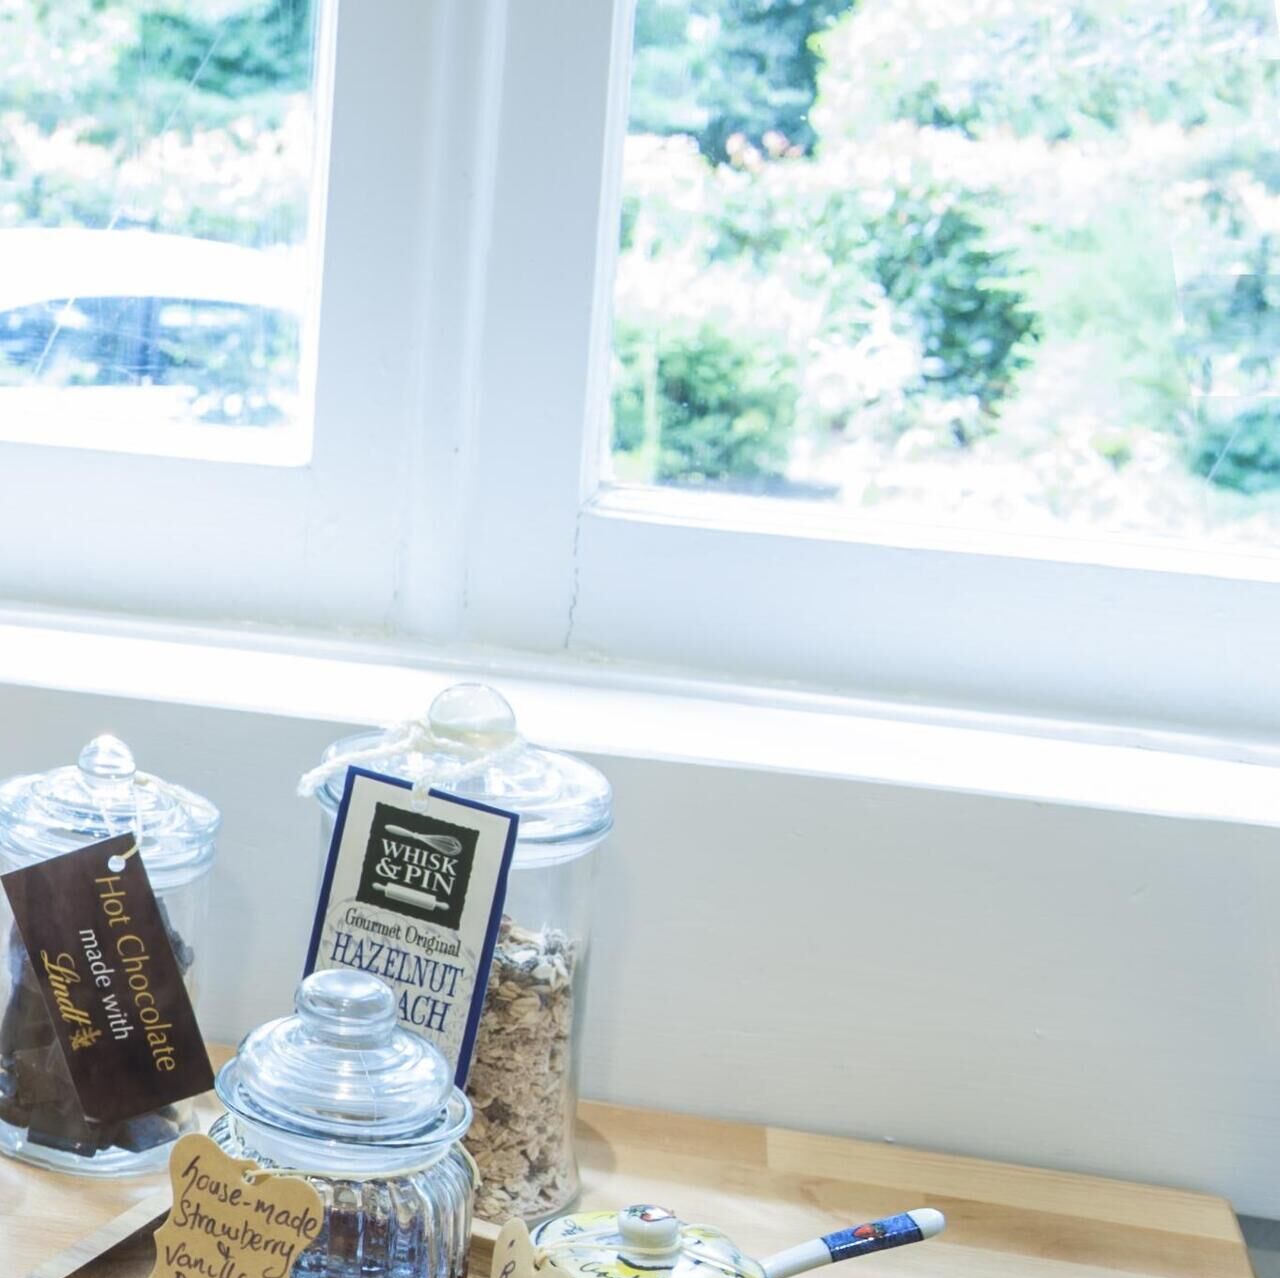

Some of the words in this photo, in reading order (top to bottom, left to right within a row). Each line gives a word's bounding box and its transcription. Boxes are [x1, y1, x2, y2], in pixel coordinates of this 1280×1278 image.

[375, 857, 402, 880] &
[404, 865, 457, 896] PIN
[382, 838, 459, 877] WHISK
[345, 907, 401, 941] Gourmet
[404, 925, 462, 958] Original
[40, 950, 92, 1025] Lindt
[79, 929, 115, 988] made
[101, 993, 134, 1040] with
[94, 876, 131, 928] Hot
[116, 934, 176, 1071] Chocolate
[330, 931, 464, 998] HAZELNUT
[398, 989, 453, 1033] ACH
